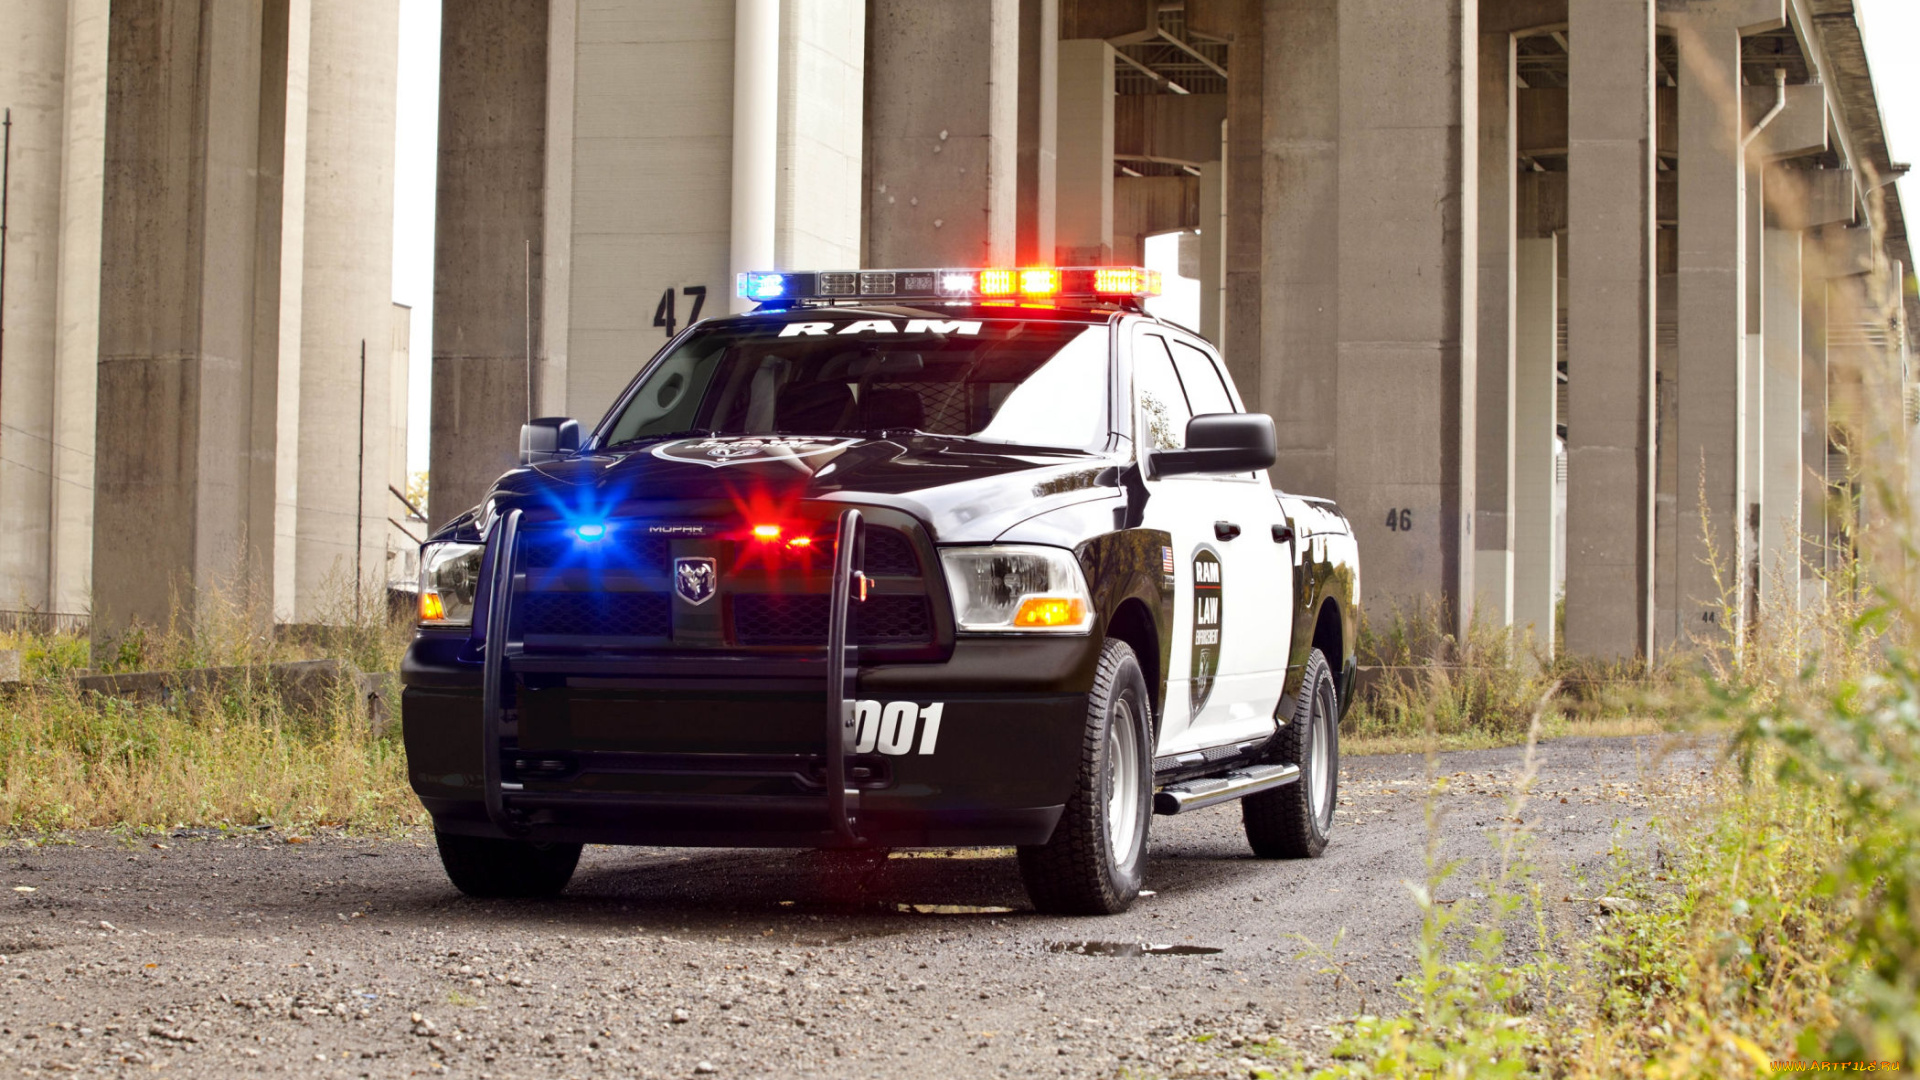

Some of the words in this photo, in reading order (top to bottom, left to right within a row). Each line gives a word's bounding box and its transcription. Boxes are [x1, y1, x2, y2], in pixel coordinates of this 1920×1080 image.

[653, 286, 706, 337] 47
[778, 320, 982, 337] RAM
[1385, 508, 1412, 532] 46
[1195, 561, 1220, 583] RAM
[1198, 597, 1218, 625] LAW
[1702, 611, 1715, 624] 44
